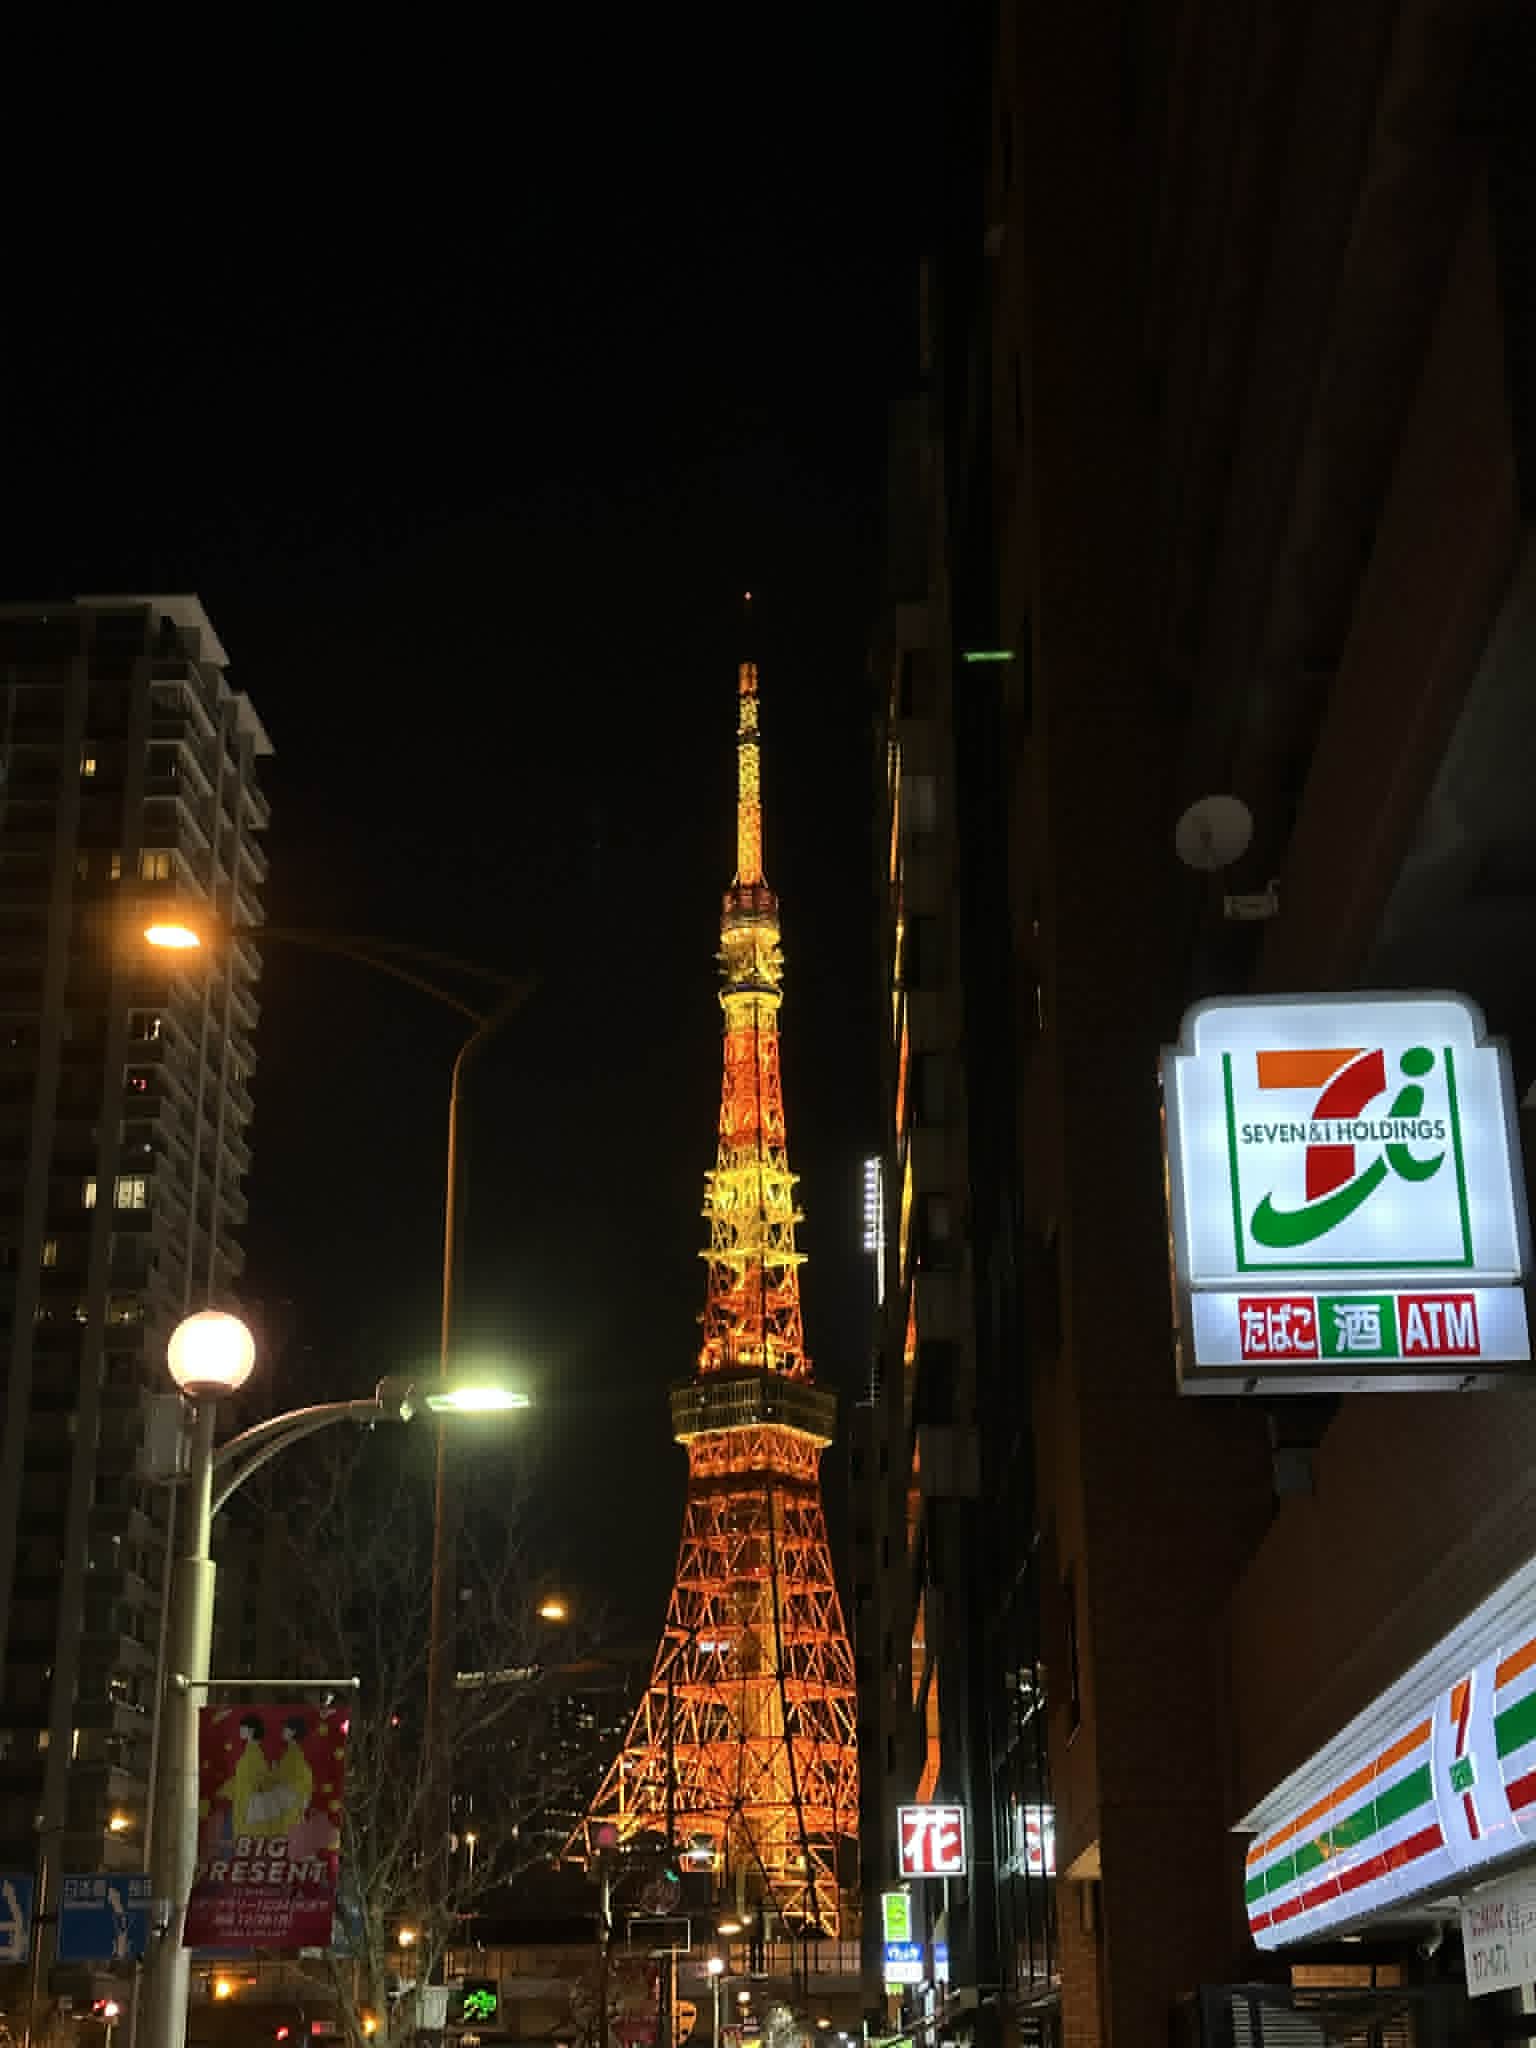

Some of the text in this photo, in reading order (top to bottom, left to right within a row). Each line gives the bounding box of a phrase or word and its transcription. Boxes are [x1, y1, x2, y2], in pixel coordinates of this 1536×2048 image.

[1337, 1119, 1446, 1141] HOLDINGS
[1241, 1301, 1479, 1353] たばこ 酒 ATM
[236, 1835, 289, 1858] BIG
[903, 1809, 961, 1873] 花
[206, 1857, 328, 1884] RESENT
